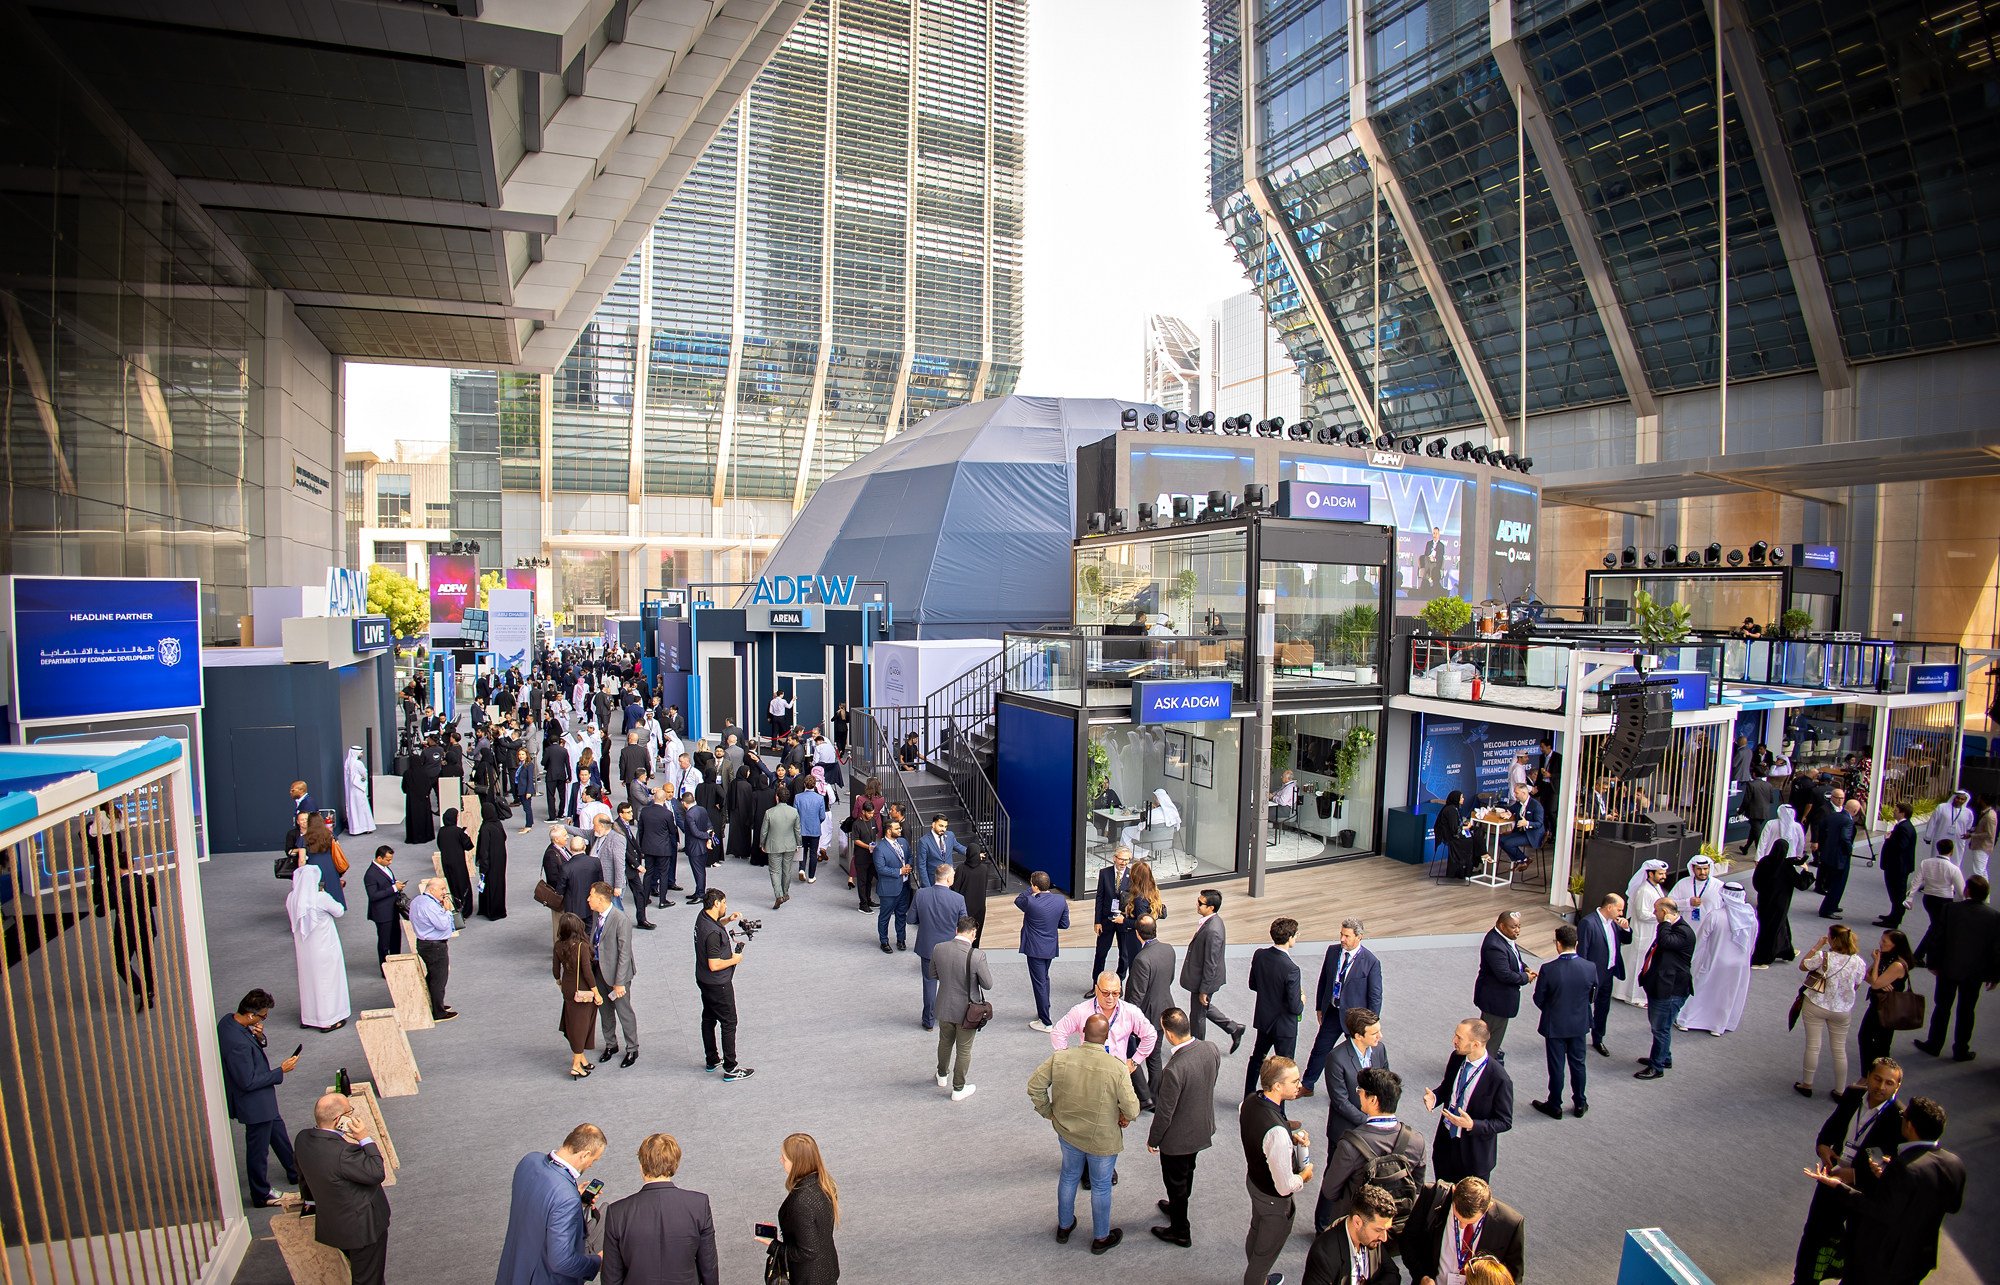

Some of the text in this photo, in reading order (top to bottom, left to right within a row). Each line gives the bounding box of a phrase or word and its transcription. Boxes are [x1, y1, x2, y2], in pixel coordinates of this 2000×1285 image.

[1322, 496, 1356, 508] ADGM
[1496, 519, 1532, 545] ADFW
[752, 574, 858, 605] ADFW
[70, 613, 114, 621] HEADLINE
[773, 613, 800, 623] ARENA
[364, 625, 385, 644] LIVE
[40, 657, 79, 665] DEPARTMENT
[117, 654, 155, 662] DEVELOPMENT
[1153, 696, 1219, 710] ASK ADGM
[1483, 741, 1509, 749] WELCOME
[1483, 750, 1493, 758] THE
